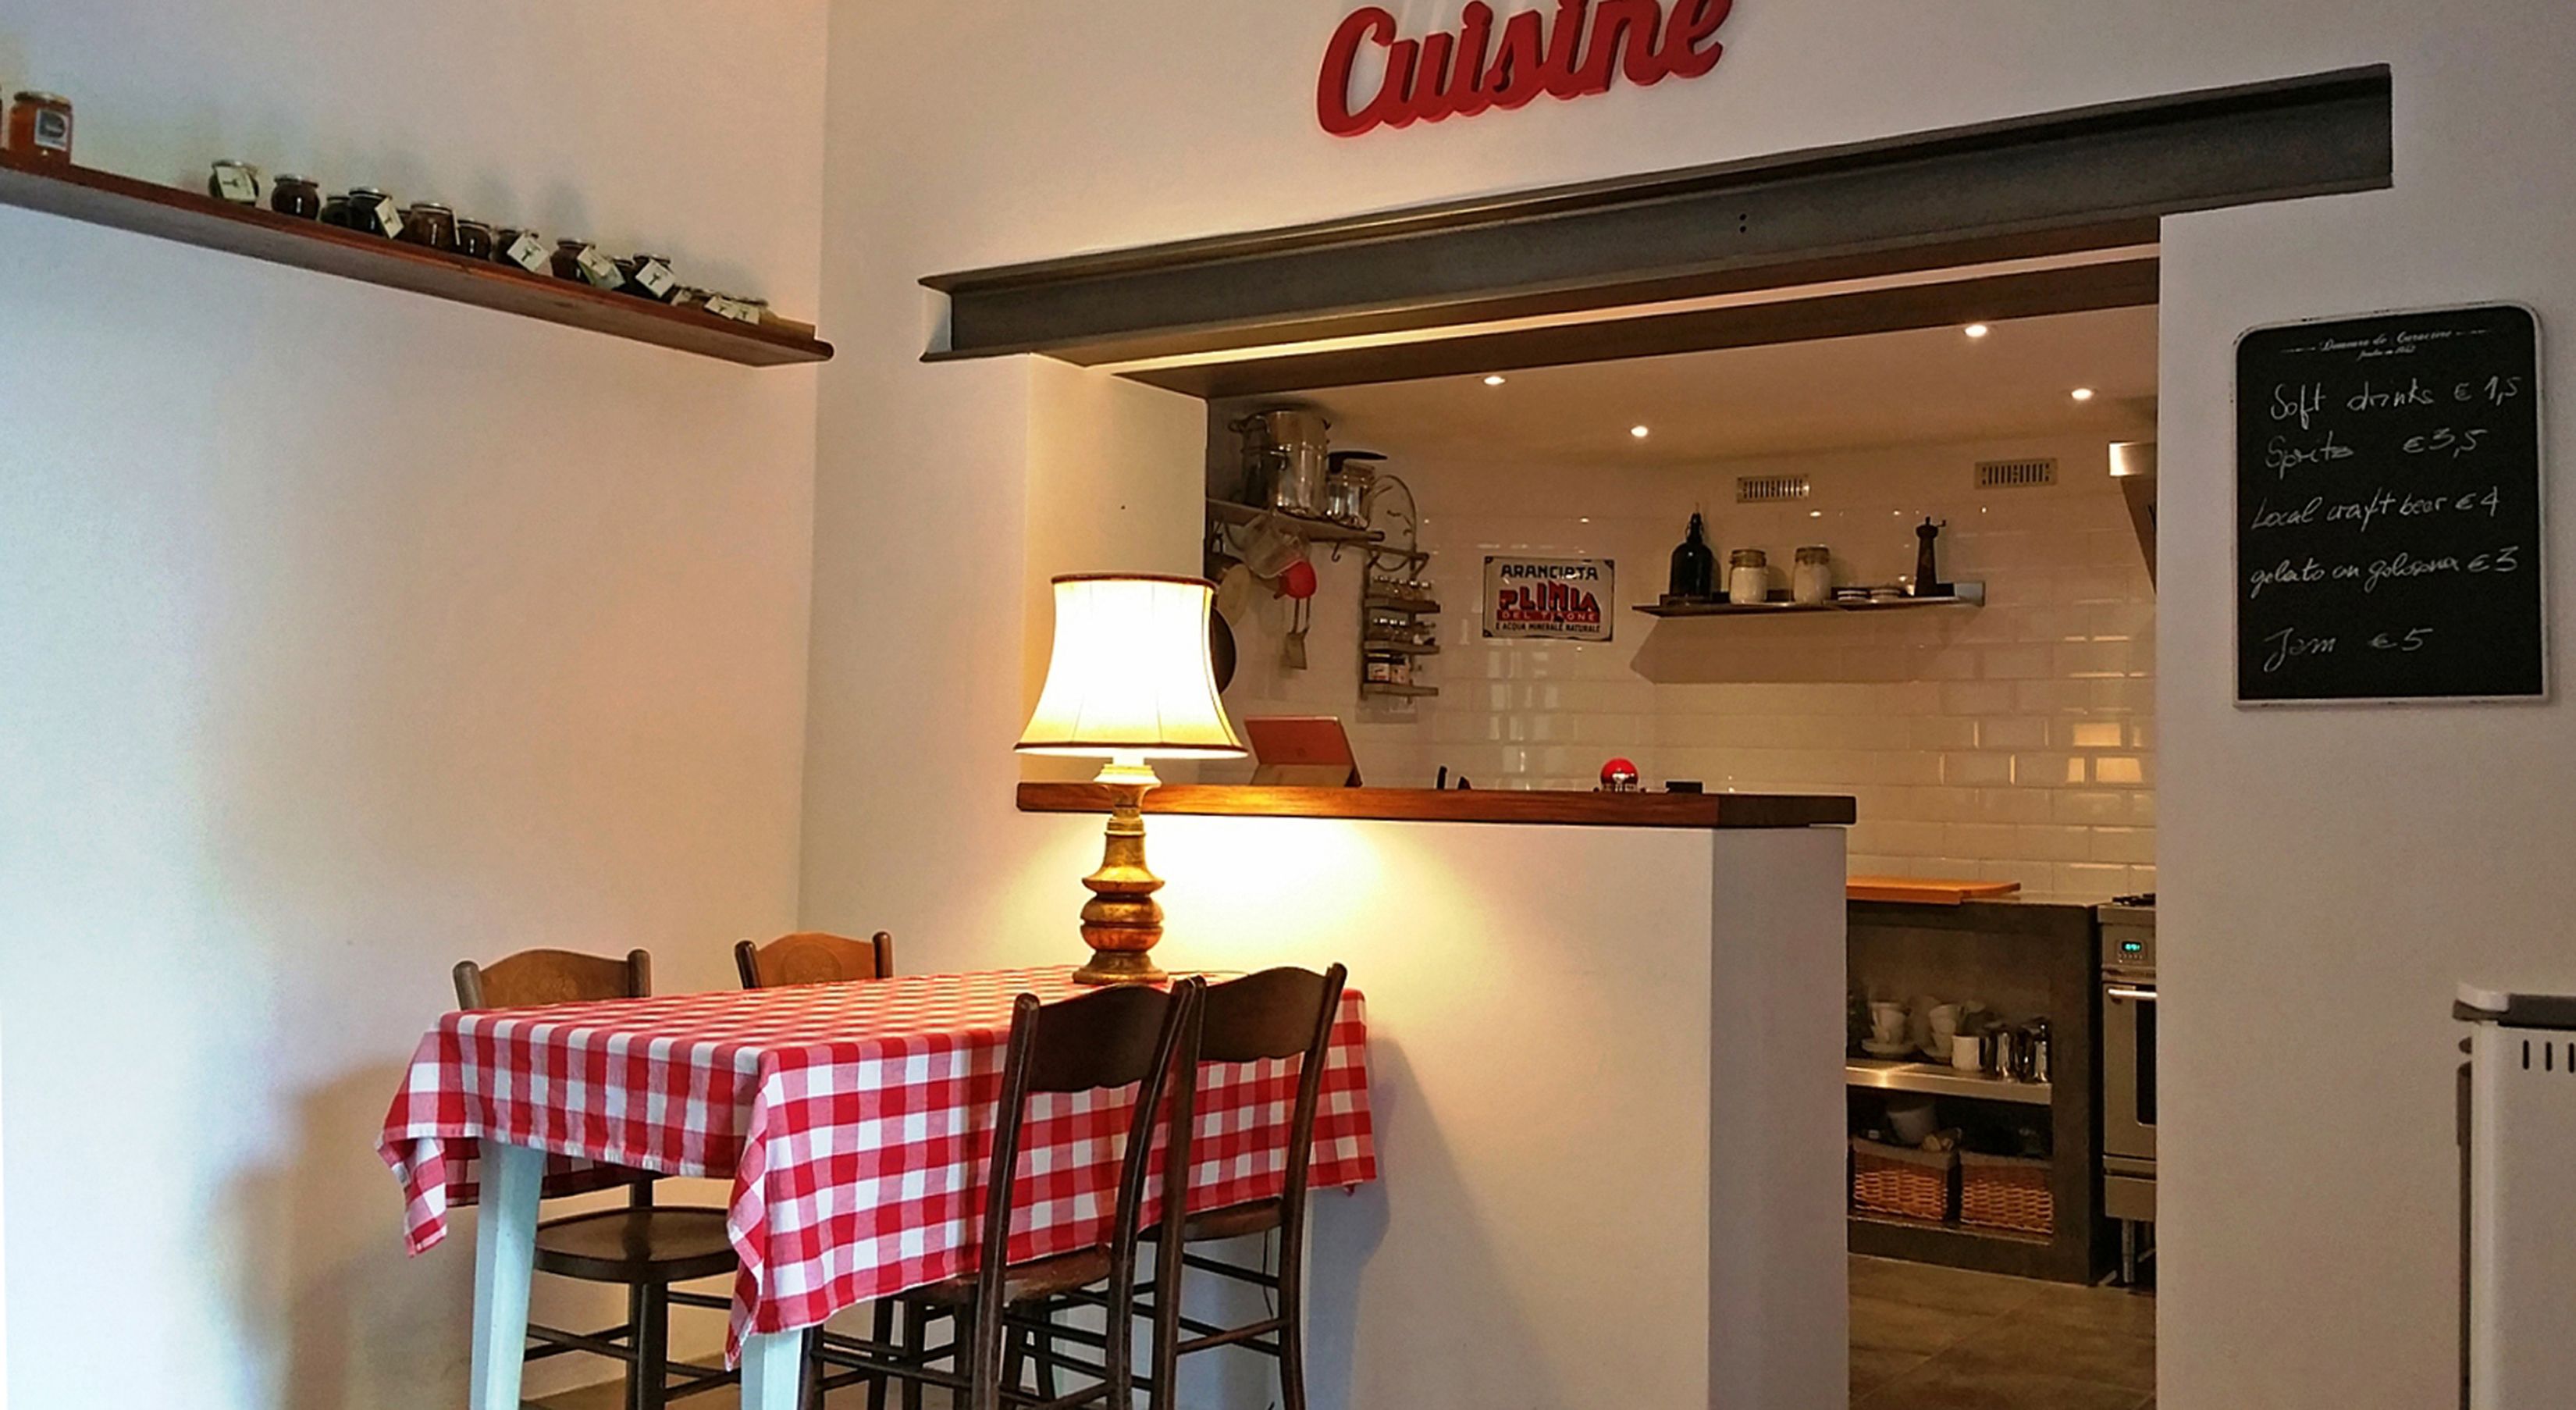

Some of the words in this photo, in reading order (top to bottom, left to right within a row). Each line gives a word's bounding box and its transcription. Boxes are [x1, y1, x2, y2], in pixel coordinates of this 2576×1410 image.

[1316, 0, 1733, 138] Cuisine
[2270, 382, 2326, 430] Soft
[2347, 378, 2434, 411] drinks
[2250, 496, 2322, 530] Local
[2326, 486, 2396, 532] craft
[2400, 493, 2448, 516] beer
[1500, 564, 1598, 580] ARANCIATA
[2250, 557, 2326, 600] gelato
[1499, 581, 1600, 612] PLINIA
[1501, 610, 1532, 619] DEL
[2262, 627, 2336, 673] Jam
